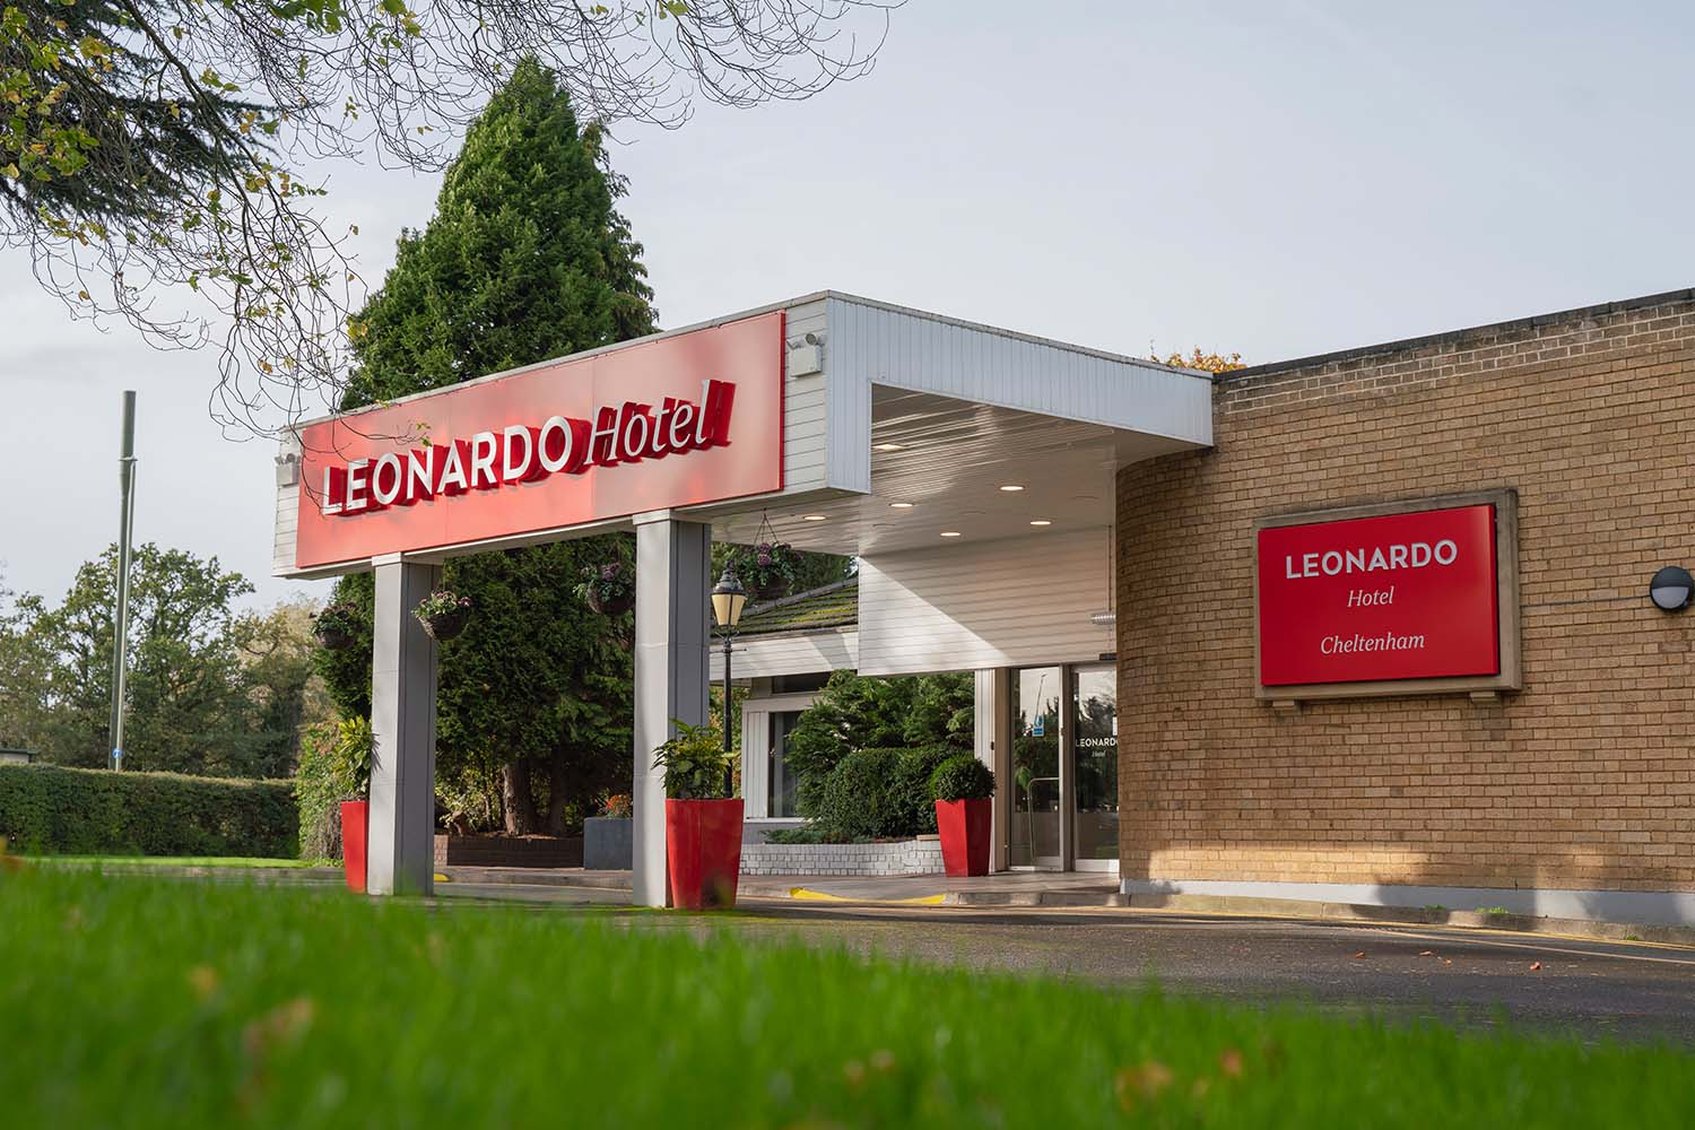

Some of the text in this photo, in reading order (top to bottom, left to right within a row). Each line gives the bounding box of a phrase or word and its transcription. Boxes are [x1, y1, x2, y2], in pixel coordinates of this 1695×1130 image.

[323, 378, 716, 515] LEONARDO Hotel
[1285, 539, 1458, 579] LEONARDO
[1346, 586, 1395, 608] Hotel
[1320, 632, 1425, 655] Cheltenham
